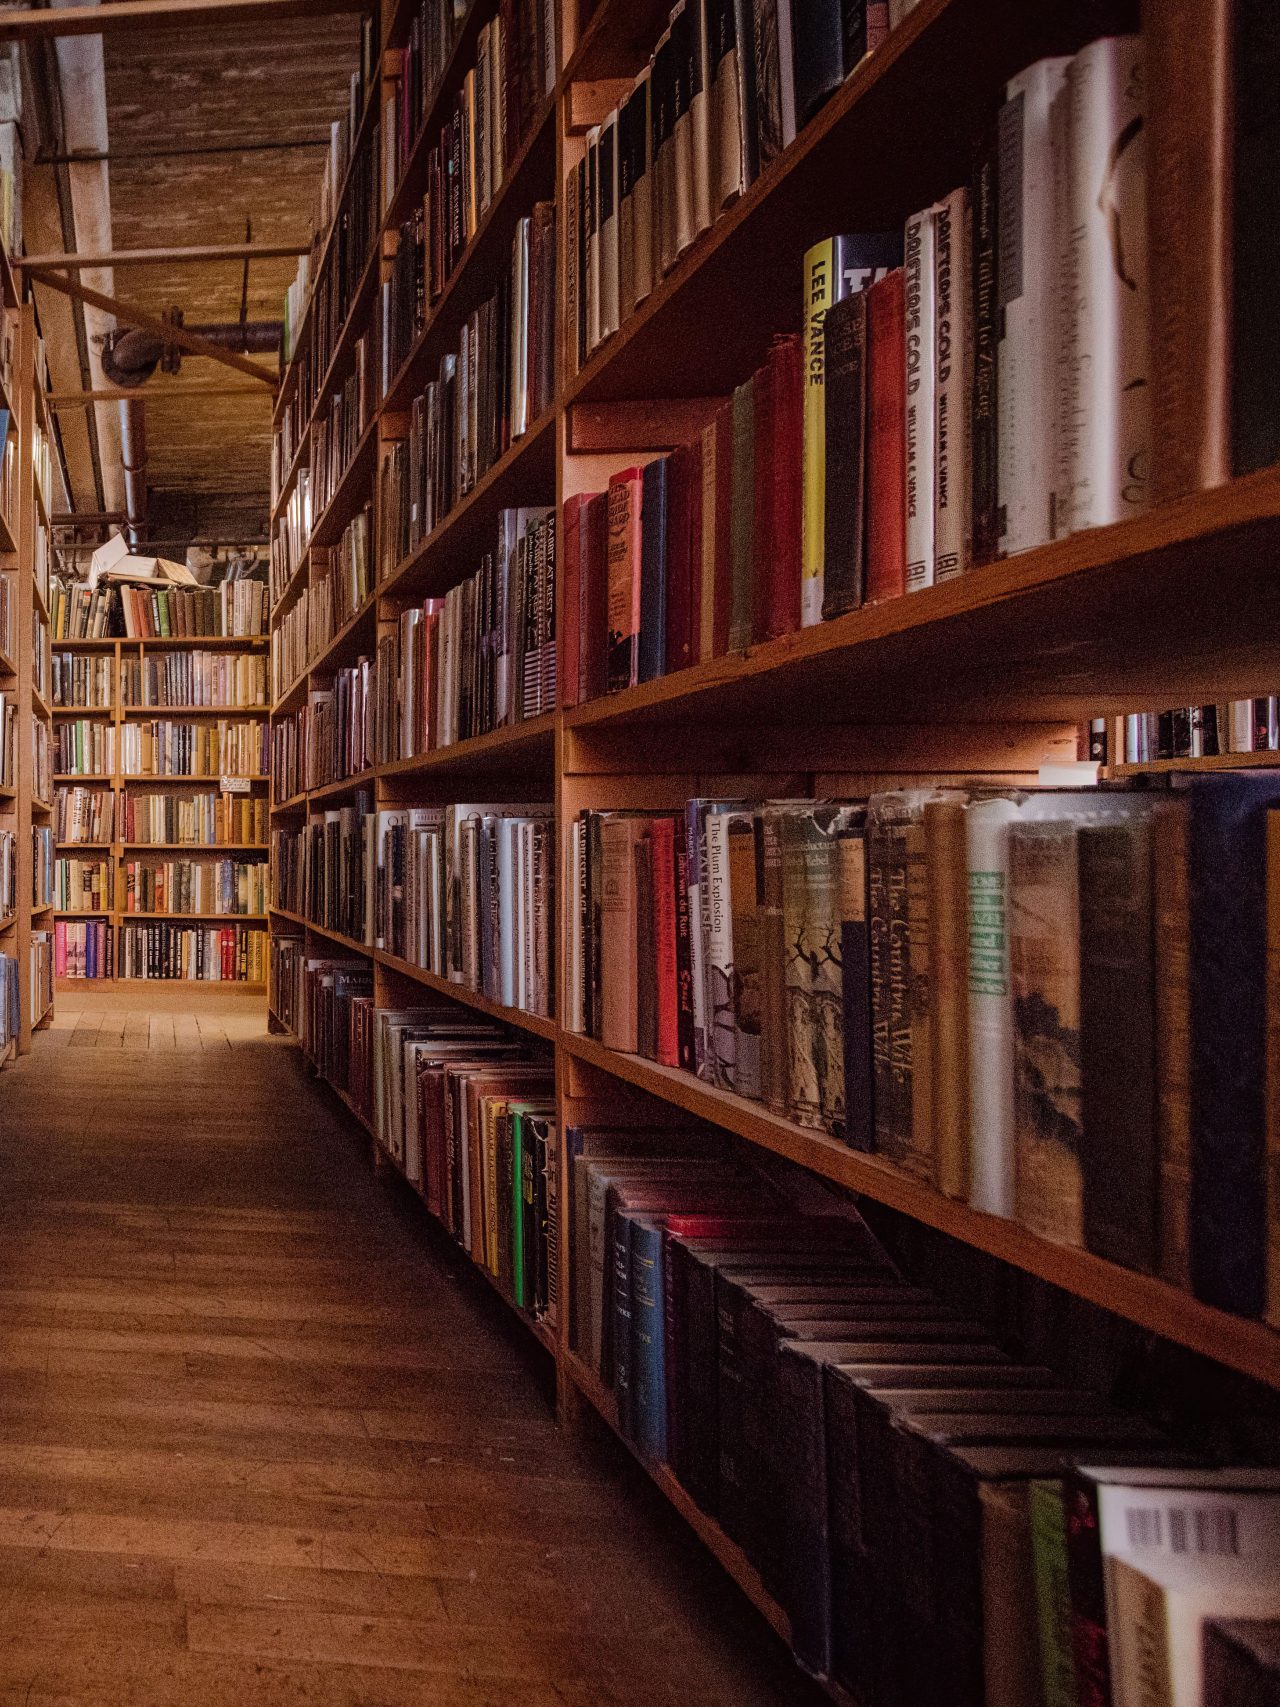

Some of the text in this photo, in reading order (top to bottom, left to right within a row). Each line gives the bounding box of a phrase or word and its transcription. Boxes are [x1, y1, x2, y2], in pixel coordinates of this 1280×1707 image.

[809, 260, 826, 387] LEE VANCE
[907, 405, 917, 462] WILLIAM
[938, 394, 948, 455] WILLIAM
[907, 478, 917, 519] VANCE
[938, 467, 947, 510] VANCE
[546, 518, 555, 613] RABBIT AT REST
[711, 820, 724, 934] The Plum Explosion
[872, 867, 883, 911] The
[890, 868, 905, 912] The
[891, 1026, 914, 1085] Wife
